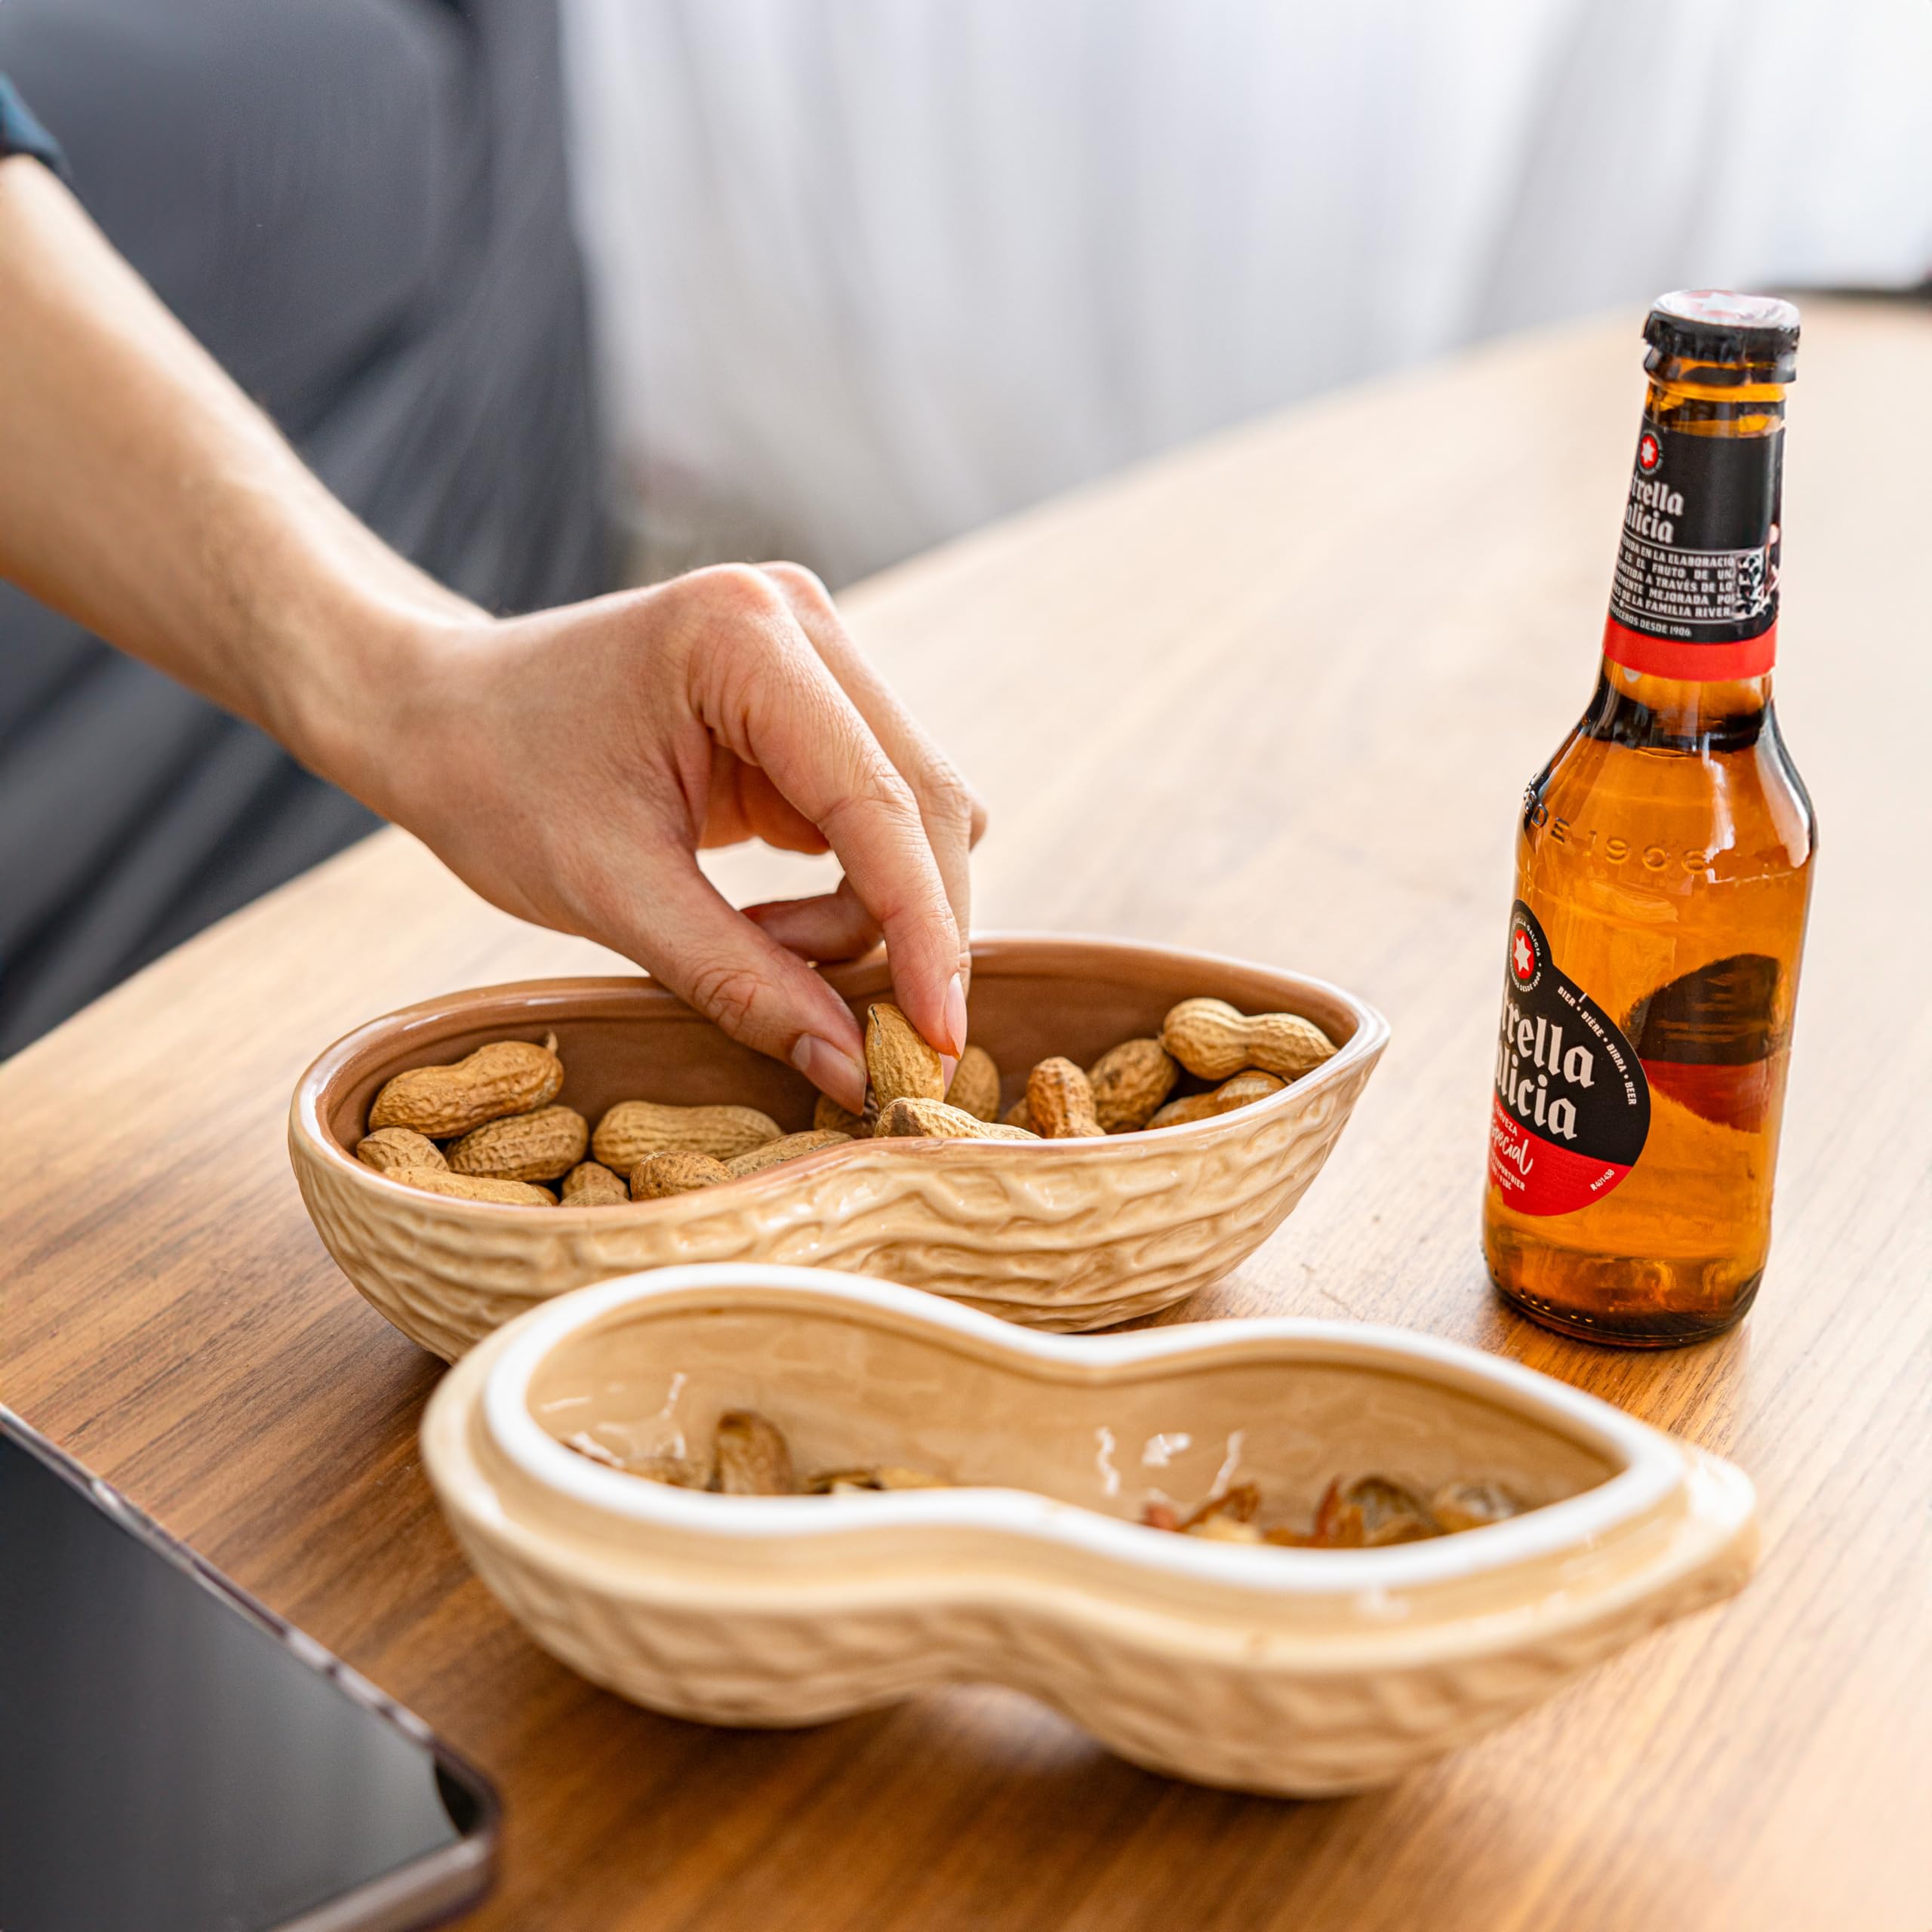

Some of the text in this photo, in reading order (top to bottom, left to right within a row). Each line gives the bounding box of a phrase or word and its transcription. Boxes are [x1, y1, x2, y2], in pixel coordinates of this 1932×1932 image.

[1630, 471, 1684, 516] trella
[1635, 557, 1646, 570] EL
[1652, 562, 1687, 579] FRUTO
[1694, 569, 1709, 580] DE
[1641, 546, 1651, 558] EN
[1653, 550, 1666, 564] LA
[1668, 552, 1736, 568] ELABORACIÓ
[1645, 574, 1654, 585] A
[1656, 577, 1698, 593] TRAVÉS
[1701, 581, 1715, 593] DE
[1622, 589, 1631, 601] DE
[1632, 595, 1644, 607] LA
[1645, 599, 1691, 617] FAMILIA
[1695, 606, 1733, 618] RIVER
[1649, 588, 1709, 605] MEJORADA
[1640, 619, 1667, 634] DESDE
[1669, 625, 1692, 637] 1906
[1526, 924, 1541, 957] GALICIA
[1557, 986, 1638, 1106] BIER BIÈRE BIRRA BEER
[1589, 1168, 1615, 1192] R401438
